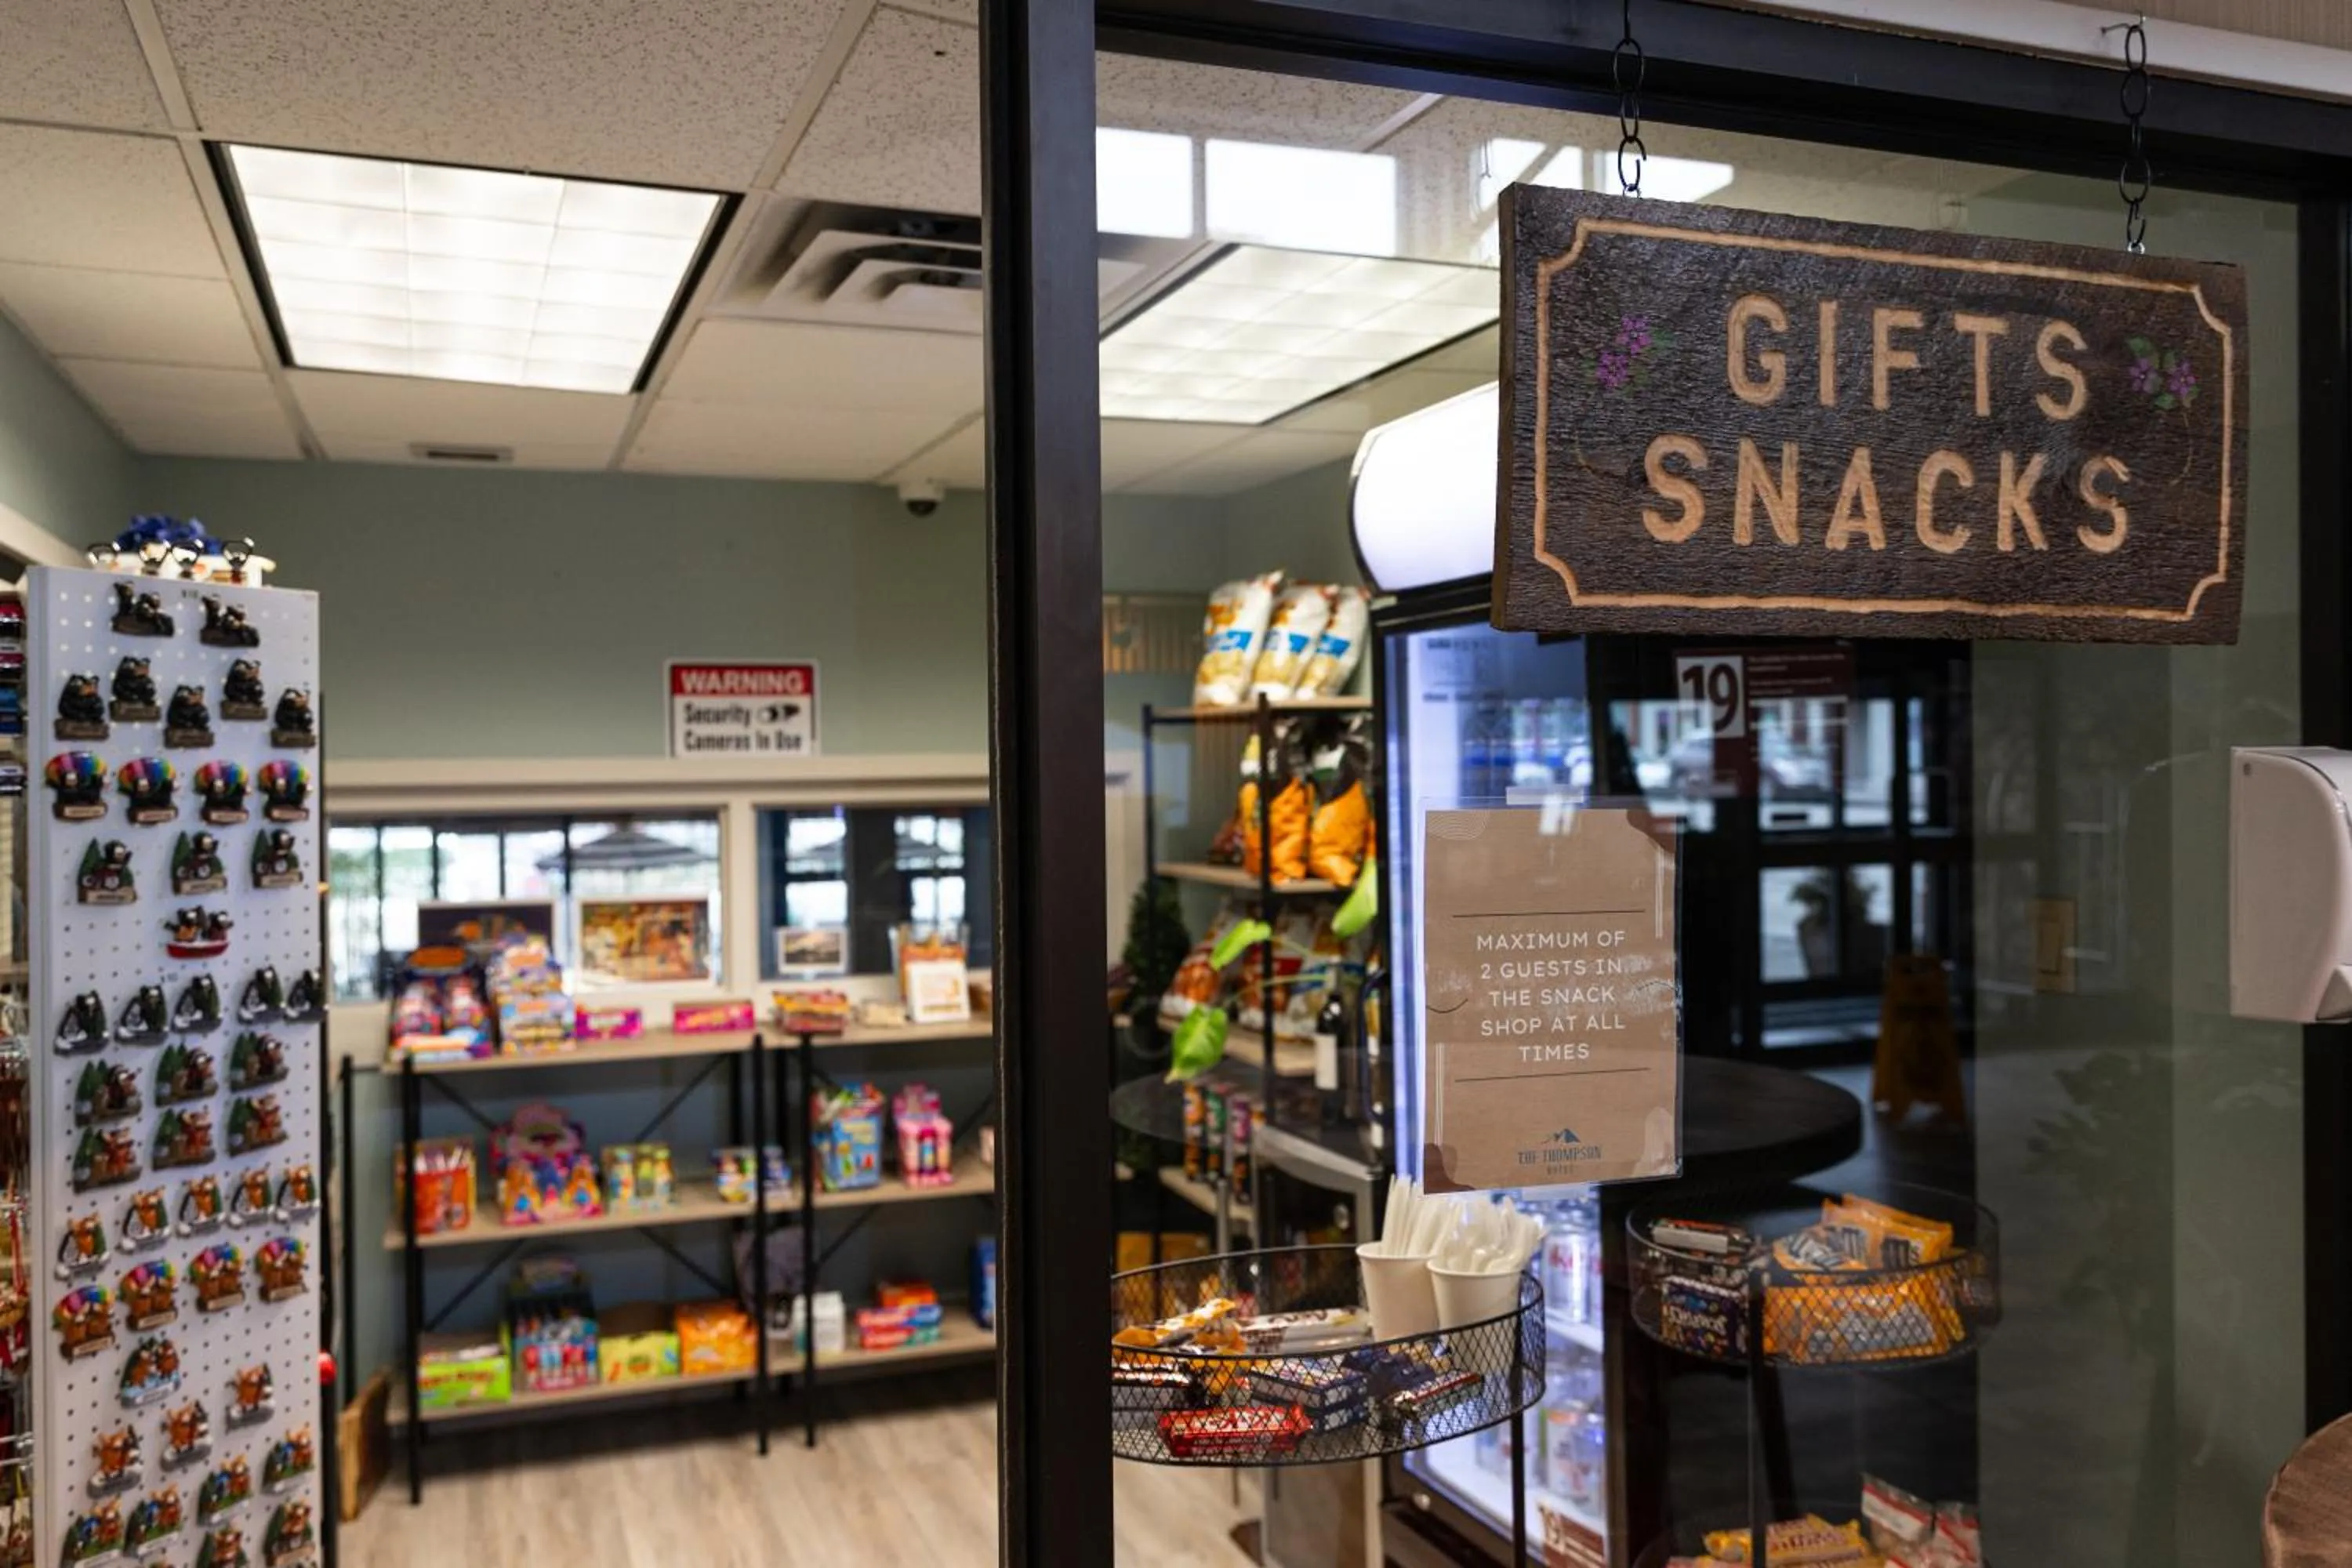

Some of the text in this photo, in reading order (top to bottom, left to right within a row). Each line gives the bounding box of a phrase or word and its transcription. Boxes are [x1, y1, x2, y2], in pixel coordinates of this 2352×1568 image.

[1727, 293, 2089, 422] GIFTS
[1642, 434, 2131, 555] SNACKS
[681, 670, 803, 692] WARNING
[1682, 662, 1740, 733] 19
[684, 704, 750, 727] Security
[684, 731, 750, 752] Cameras
[775, 730, 801, 750] Use
[1477, 931, 1626, 951] MAXIMUM OF
[1480, 958, 1623, 980] 2 GUESTS IN
[1490, 985, 1615, 1007] THE SNACK
[1481, 1013, 1626, 1036] SHOP AT ALL
[1518, 1044, 1590, 1062] TIMES
